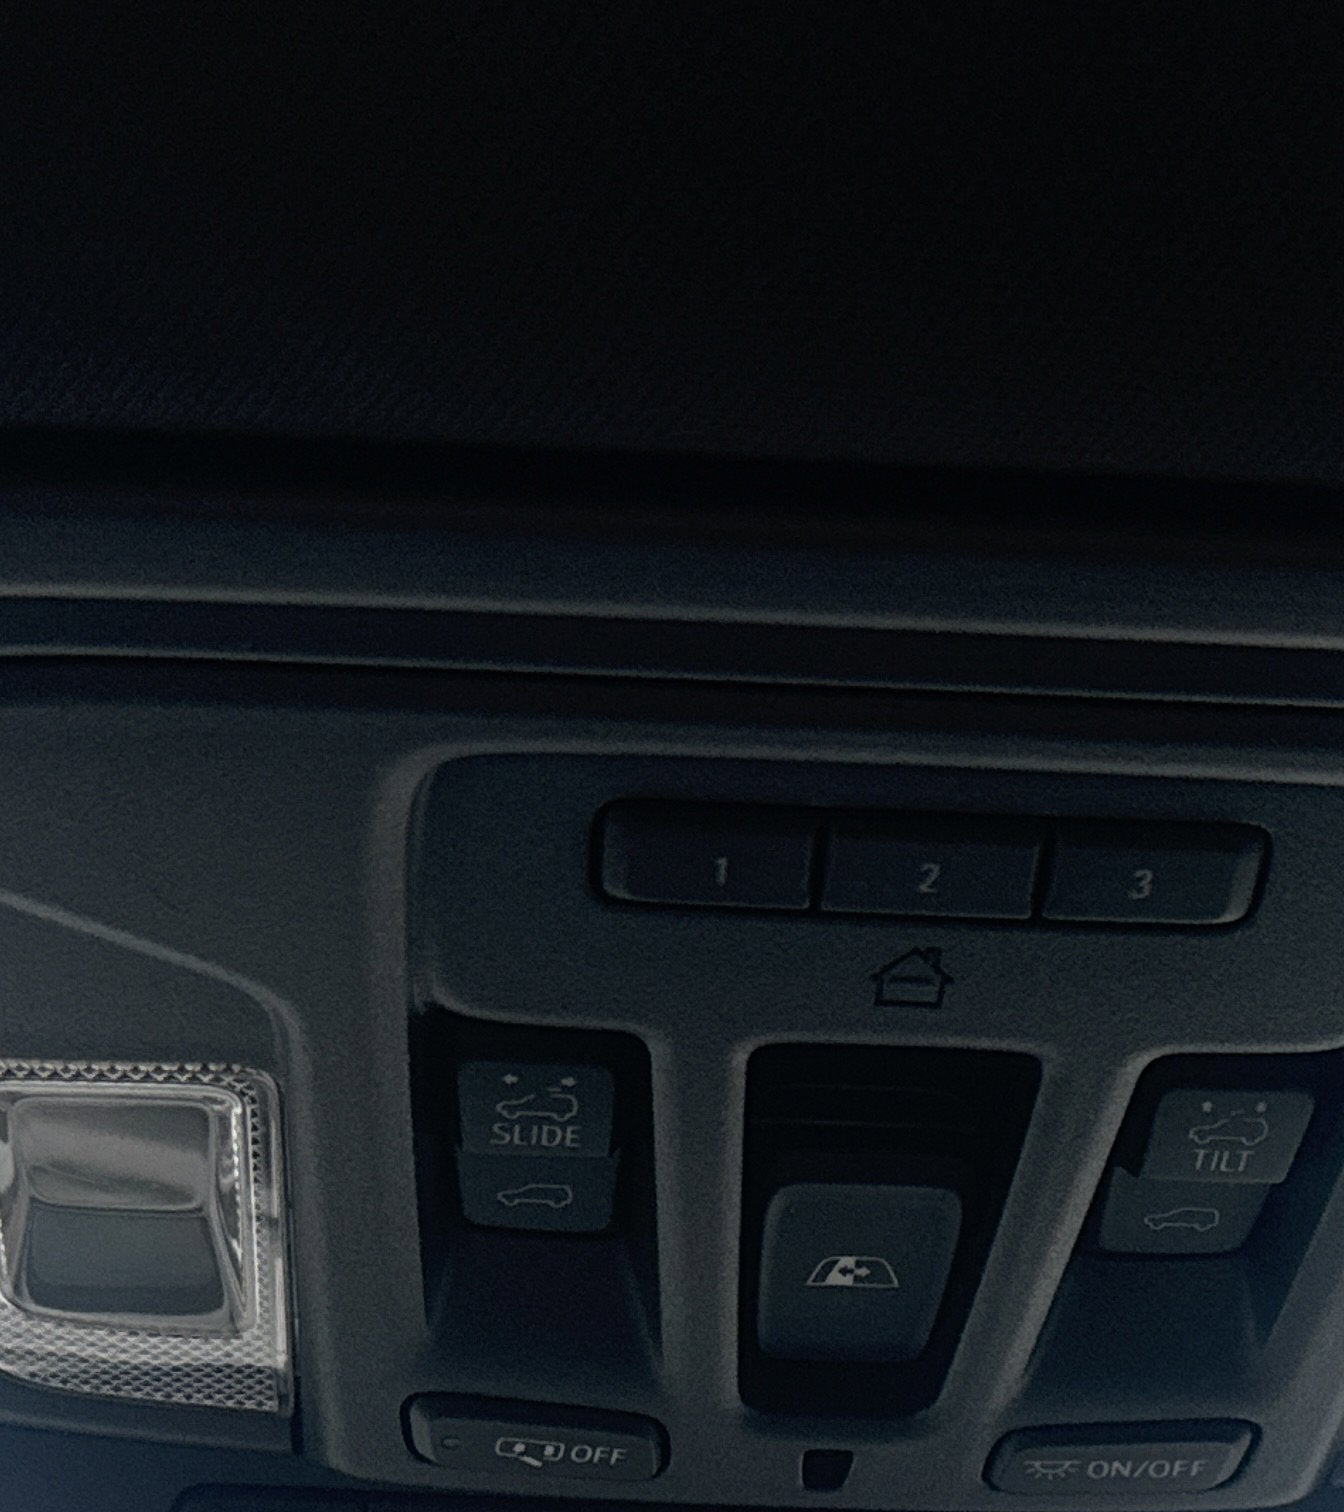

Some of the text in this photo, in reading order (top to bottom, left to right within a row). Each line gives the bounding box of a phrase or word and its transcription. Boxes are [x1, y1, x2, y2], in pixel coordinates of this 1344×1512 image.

[716, 857, 729, 884] 1
[919, 863, 942, 893] 2
[1128, 870, 1154, 899] 3
[490, 1122, 581, 1149] SLIDE
[1193, 1149, 1251, 1173] TILT
[570, 1444, 627, 1466] OFF
[1086, 1459, 1207, 1480] ON/OFF
